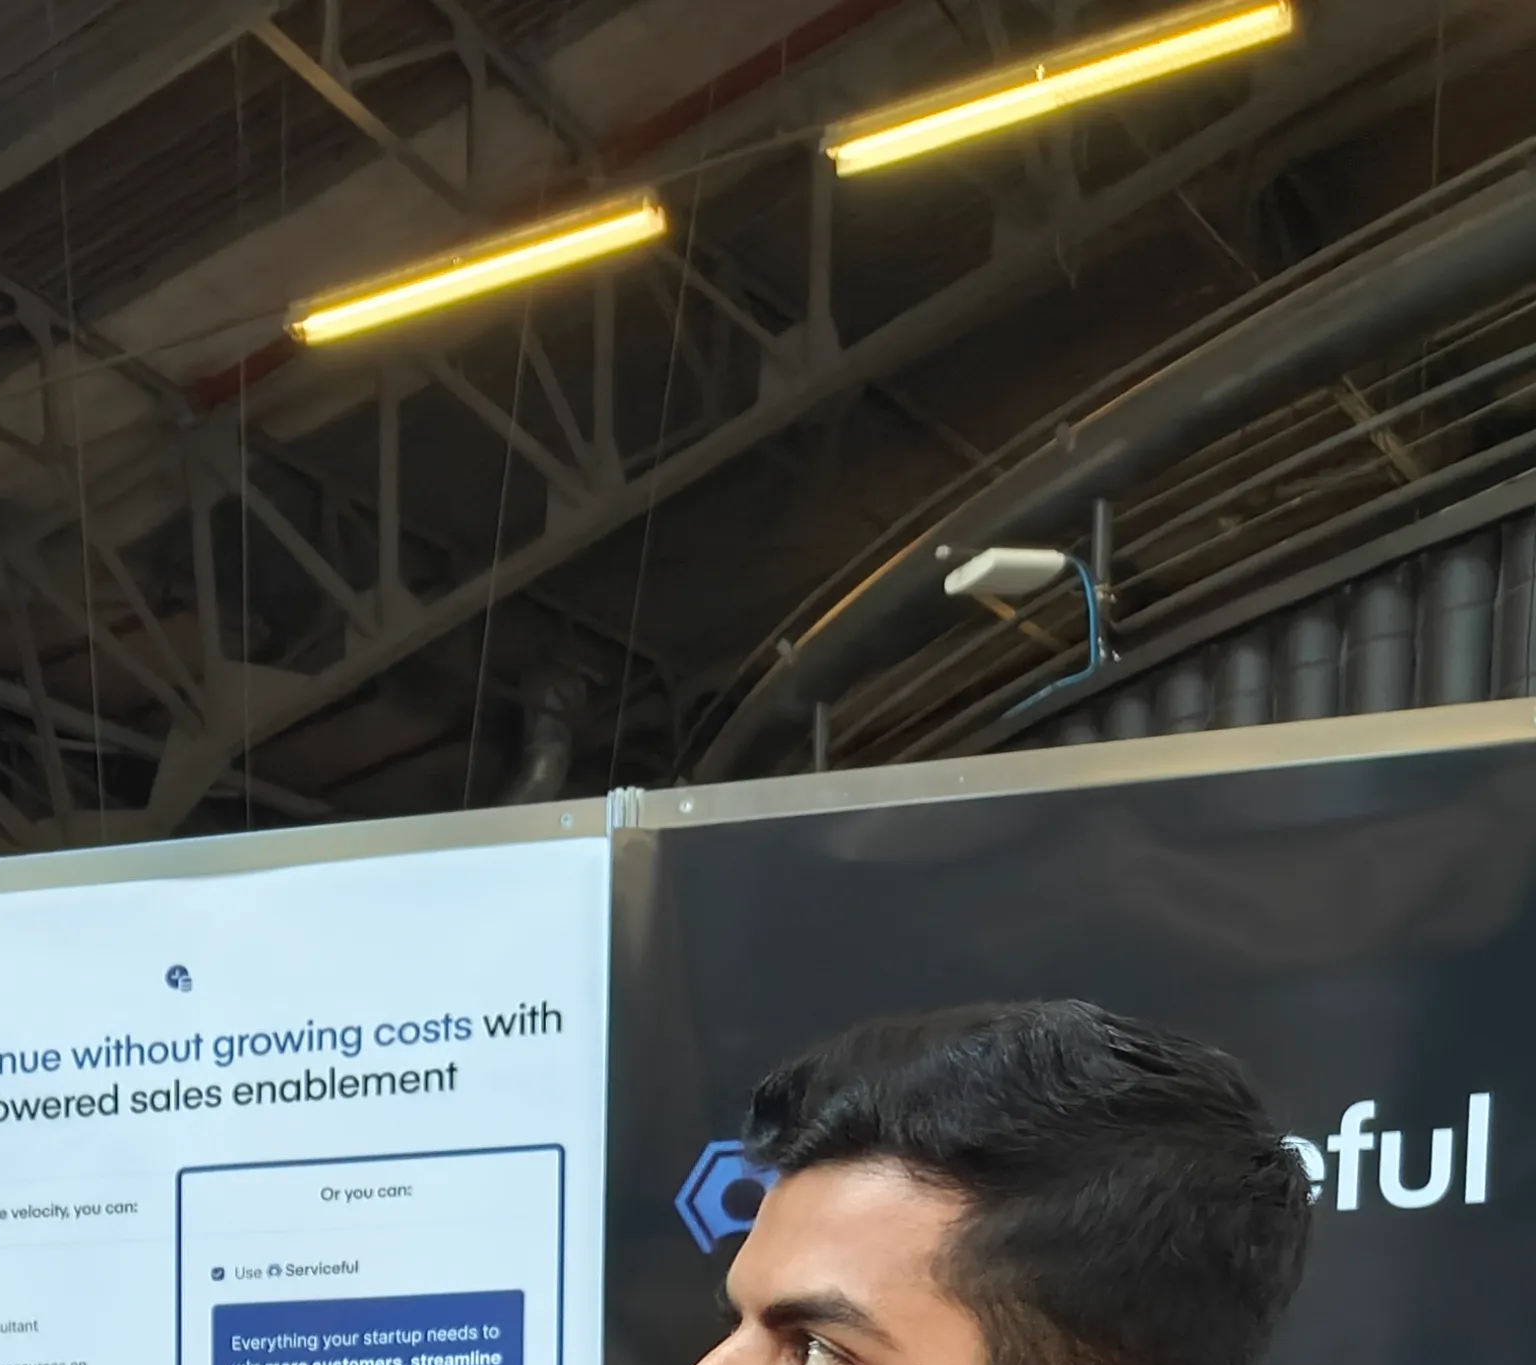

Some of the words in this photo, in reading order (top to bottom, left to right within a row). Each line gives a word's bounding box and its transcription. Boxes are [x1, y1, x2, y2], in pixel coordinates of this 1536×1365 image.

[70, 1034, 203, 1070] without
[212, 1020, 362, 1067] growing
[373, 1013, 473, 1047] costs
[483, 1000, 563, 1038] with
[129, 1079, 222, 1114] sales
[232, 1062, 458, 1106] enablement
[320, 1187, 340, 1202] Or
[344, 1186, 373, 1203] you
[377, 1184, 413, 1199] can:
[11, 1200, 70, 1221] velocity,
[73, 1202, 101, 1219] you
[105, 1201, 139, 1216] can:
[234, 1265, 262, 1281] Use
[285, 1260, 359, 1277] Serviceful
[231, 1331, 318, 1353] Everything
[322, 1333, 359, 1351] your
[363, 1327, 422, 1347] startup
[426, 1324, 478, 1343] needs
[482, 1325, 500, 1340] to
